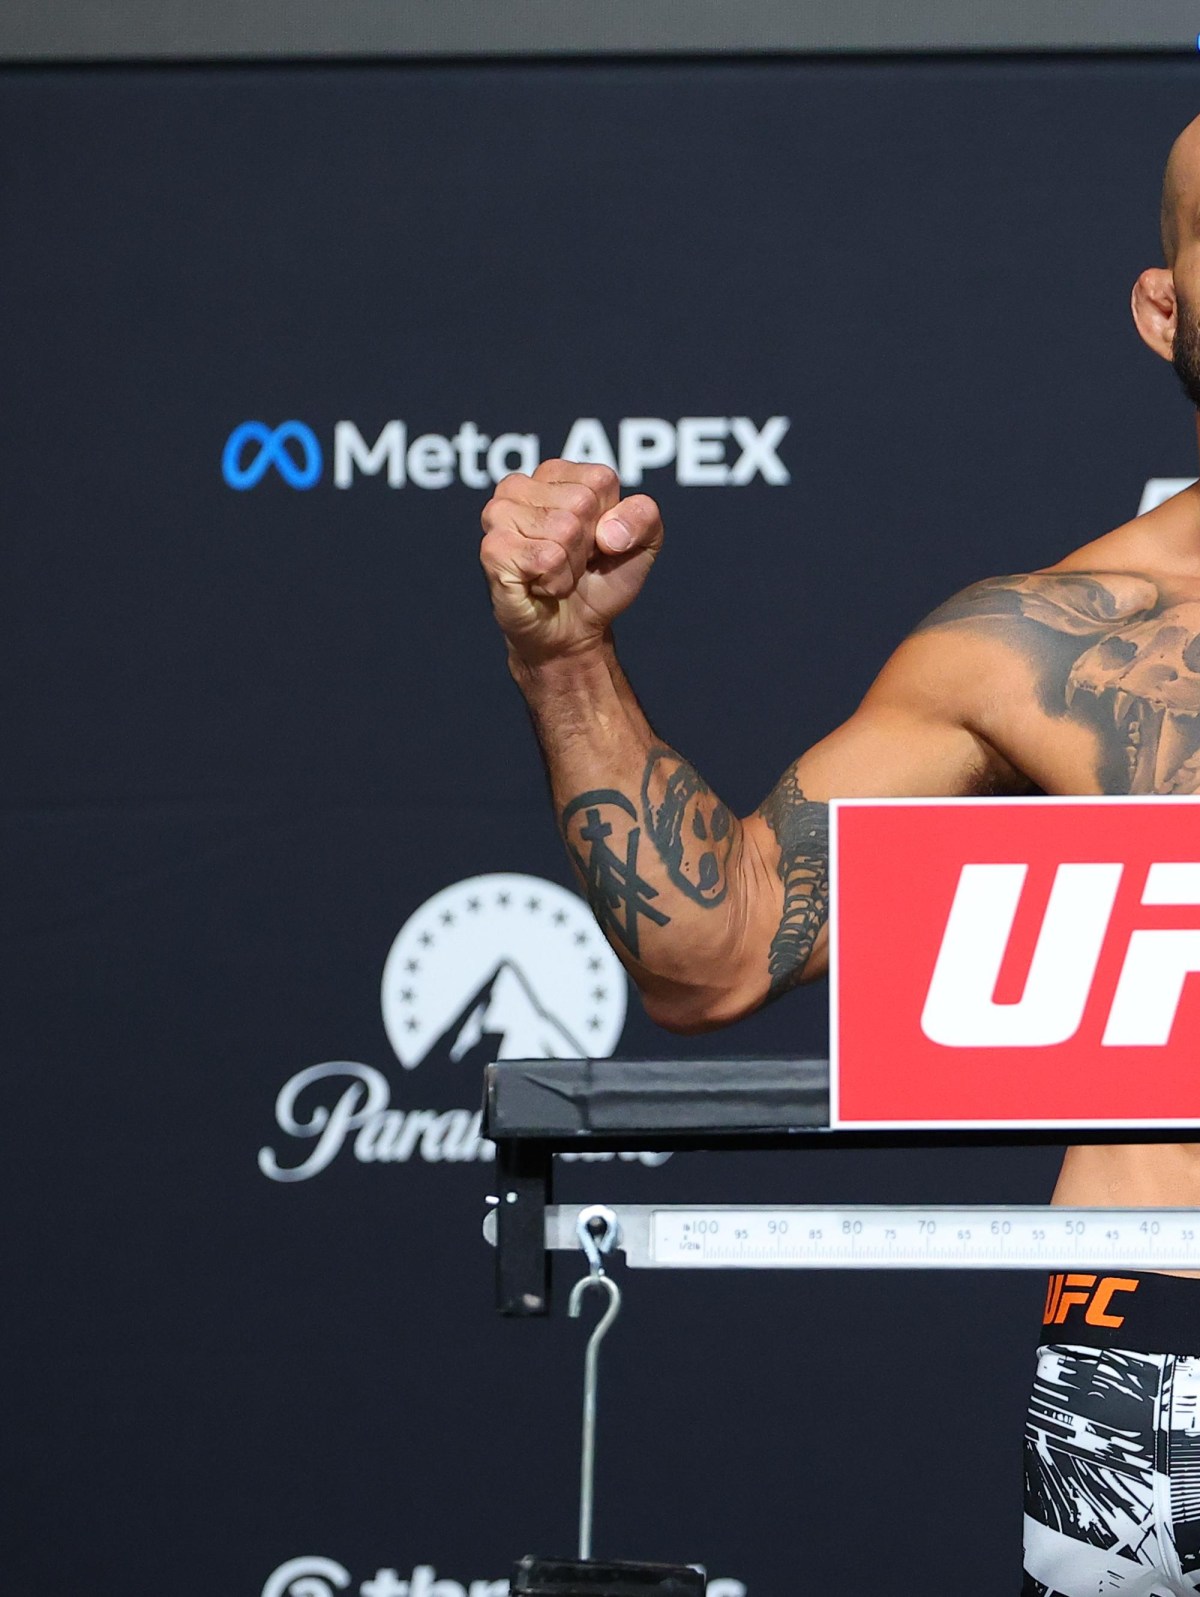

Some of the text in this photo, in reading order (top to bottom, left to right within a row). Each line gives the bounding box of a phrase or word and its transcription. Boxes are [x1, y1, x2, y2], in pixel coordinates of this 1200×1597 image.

[333, 416, 790, 489] Meta APEX
[692, 1220, 719, 1235] 100
[734, 1230, 749, 1240] 95
[767, 1220, 789, 1235] 90
[808, 1230, 823, 1240] 85
[841, 1220, 863, 1235] 80
[884, 1230, 897, 1240] 75
[917, 1220, 937, 1235] 70
[957, 1230, 972, 1240] 65
[990, 1220, 1012, 1235] 60
[1031, 1230, 1046, 1240] 55
[1064, 1220, 1086, 1235] 50
[1105, 1230, 1120, 1240] 45
[1138, 1220, 1160, 1235] 40
[1180, 1230, 1195, 1240] 35
[1042, 1273, 1140, 1329] UFC
